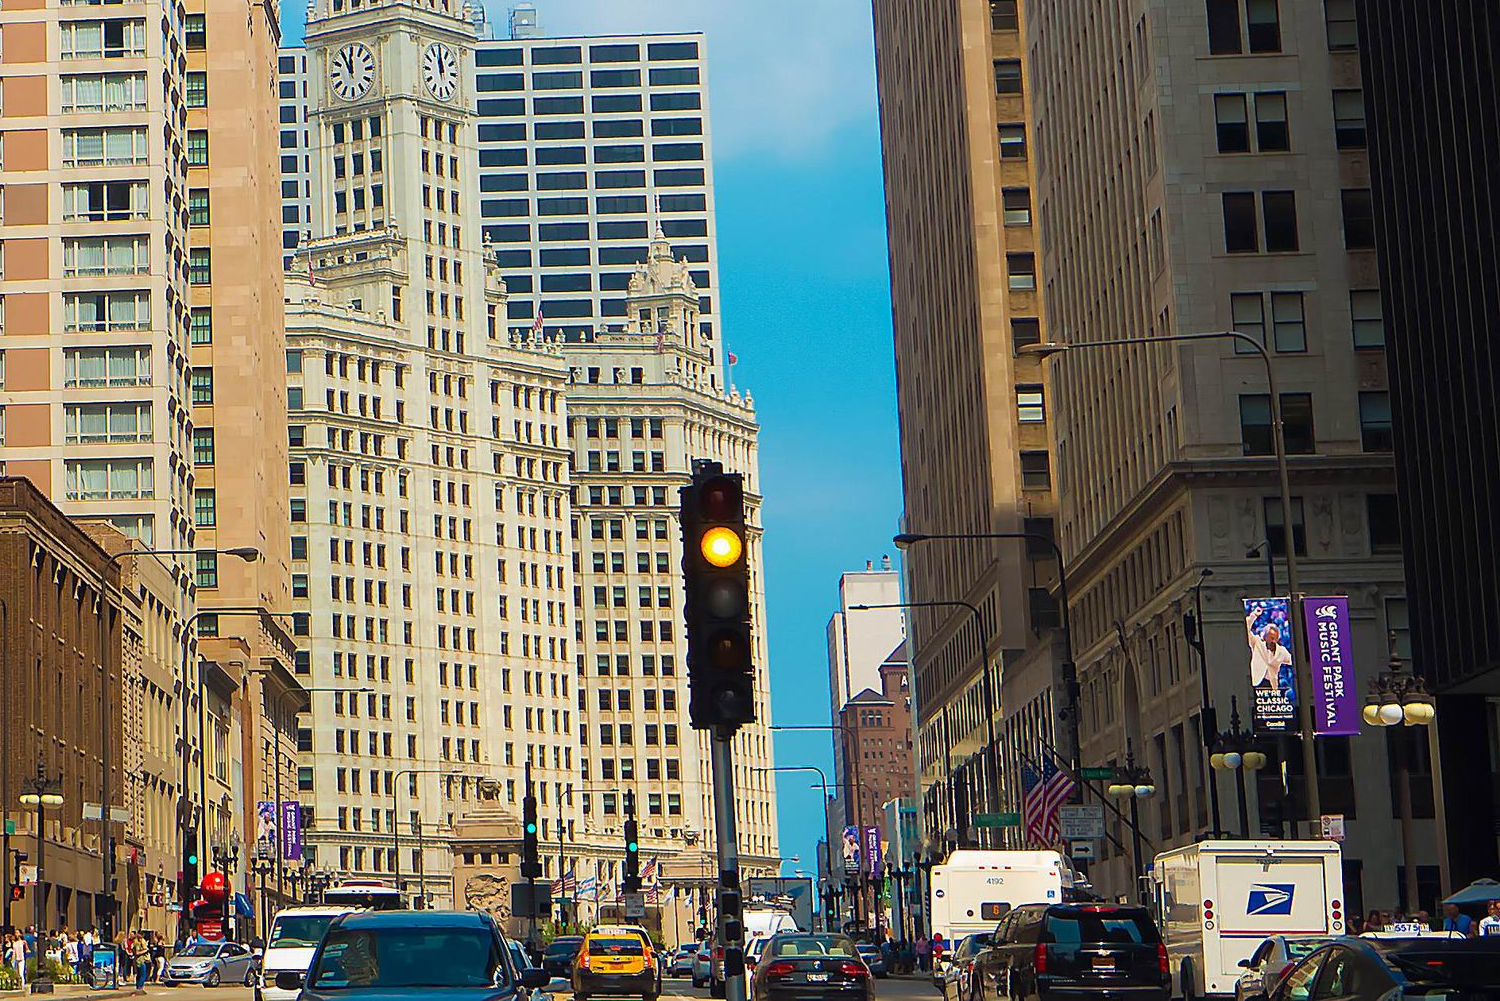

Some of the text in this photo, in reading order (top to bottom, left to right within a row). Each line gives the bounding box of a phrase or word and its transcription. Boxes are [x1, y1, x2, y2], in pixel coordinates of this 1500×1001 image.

[1328, 622, 1344, 697] GRANT PARK
[1317, 622, 1337, 728] MUSIC FESTIVAL
[1255, 689, 1282, 697] WE'RE
[1256, 697, 1290, 705] CLASSIC
[1256, 705, 1294, 713] CHICAGO
[986, 877, 1004, 885] 4192
[992, 904, 1000, 915] 6
